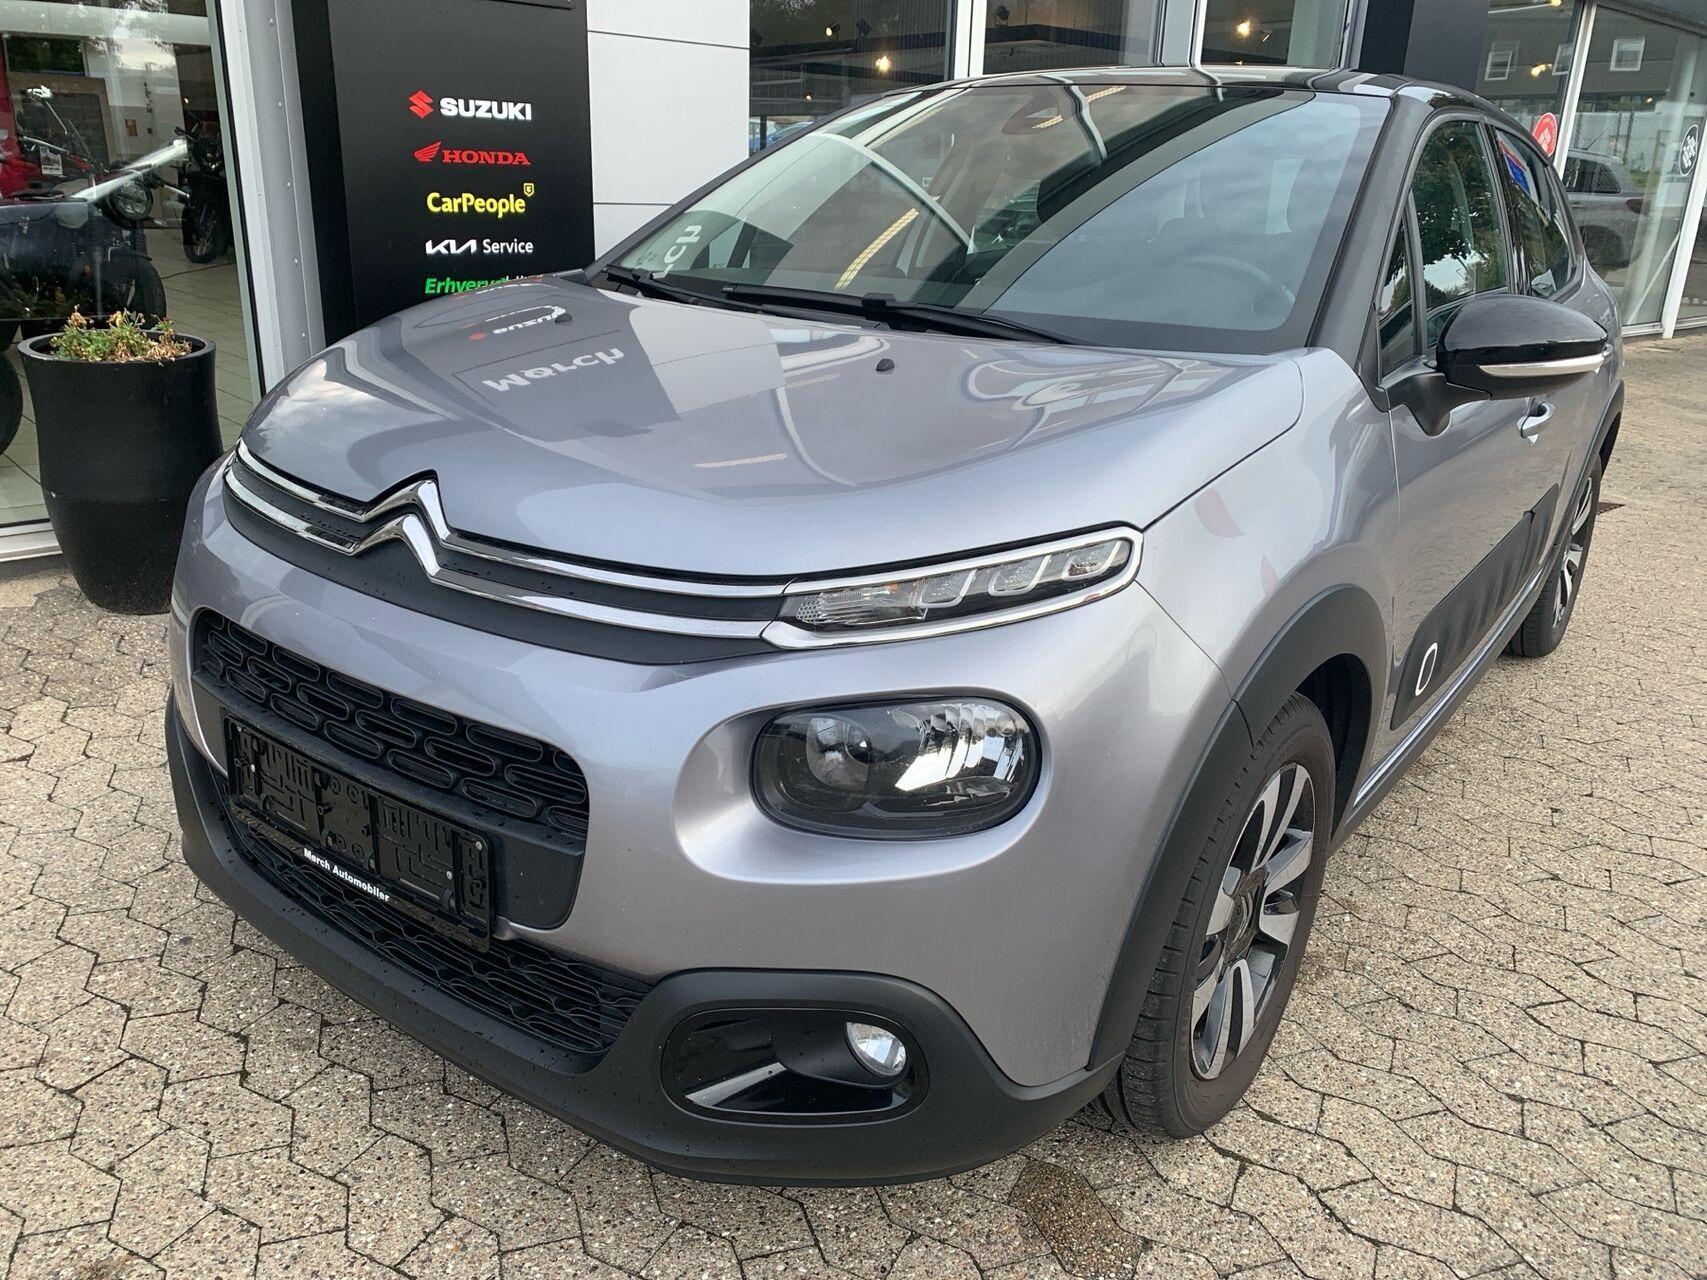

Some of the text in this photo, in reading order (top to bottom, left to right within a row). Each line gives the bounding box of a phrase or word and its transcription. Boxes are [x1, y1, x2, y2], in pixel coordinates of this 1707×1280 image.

[440, 98, 532, 120] SUZUKI
[442, 150, 531, 165] HONDA
[427, 192, 526, 218] CarPeople
[425, 239, 533, 254] KIA Service
[333, 865, 389, 902] Automobiler
